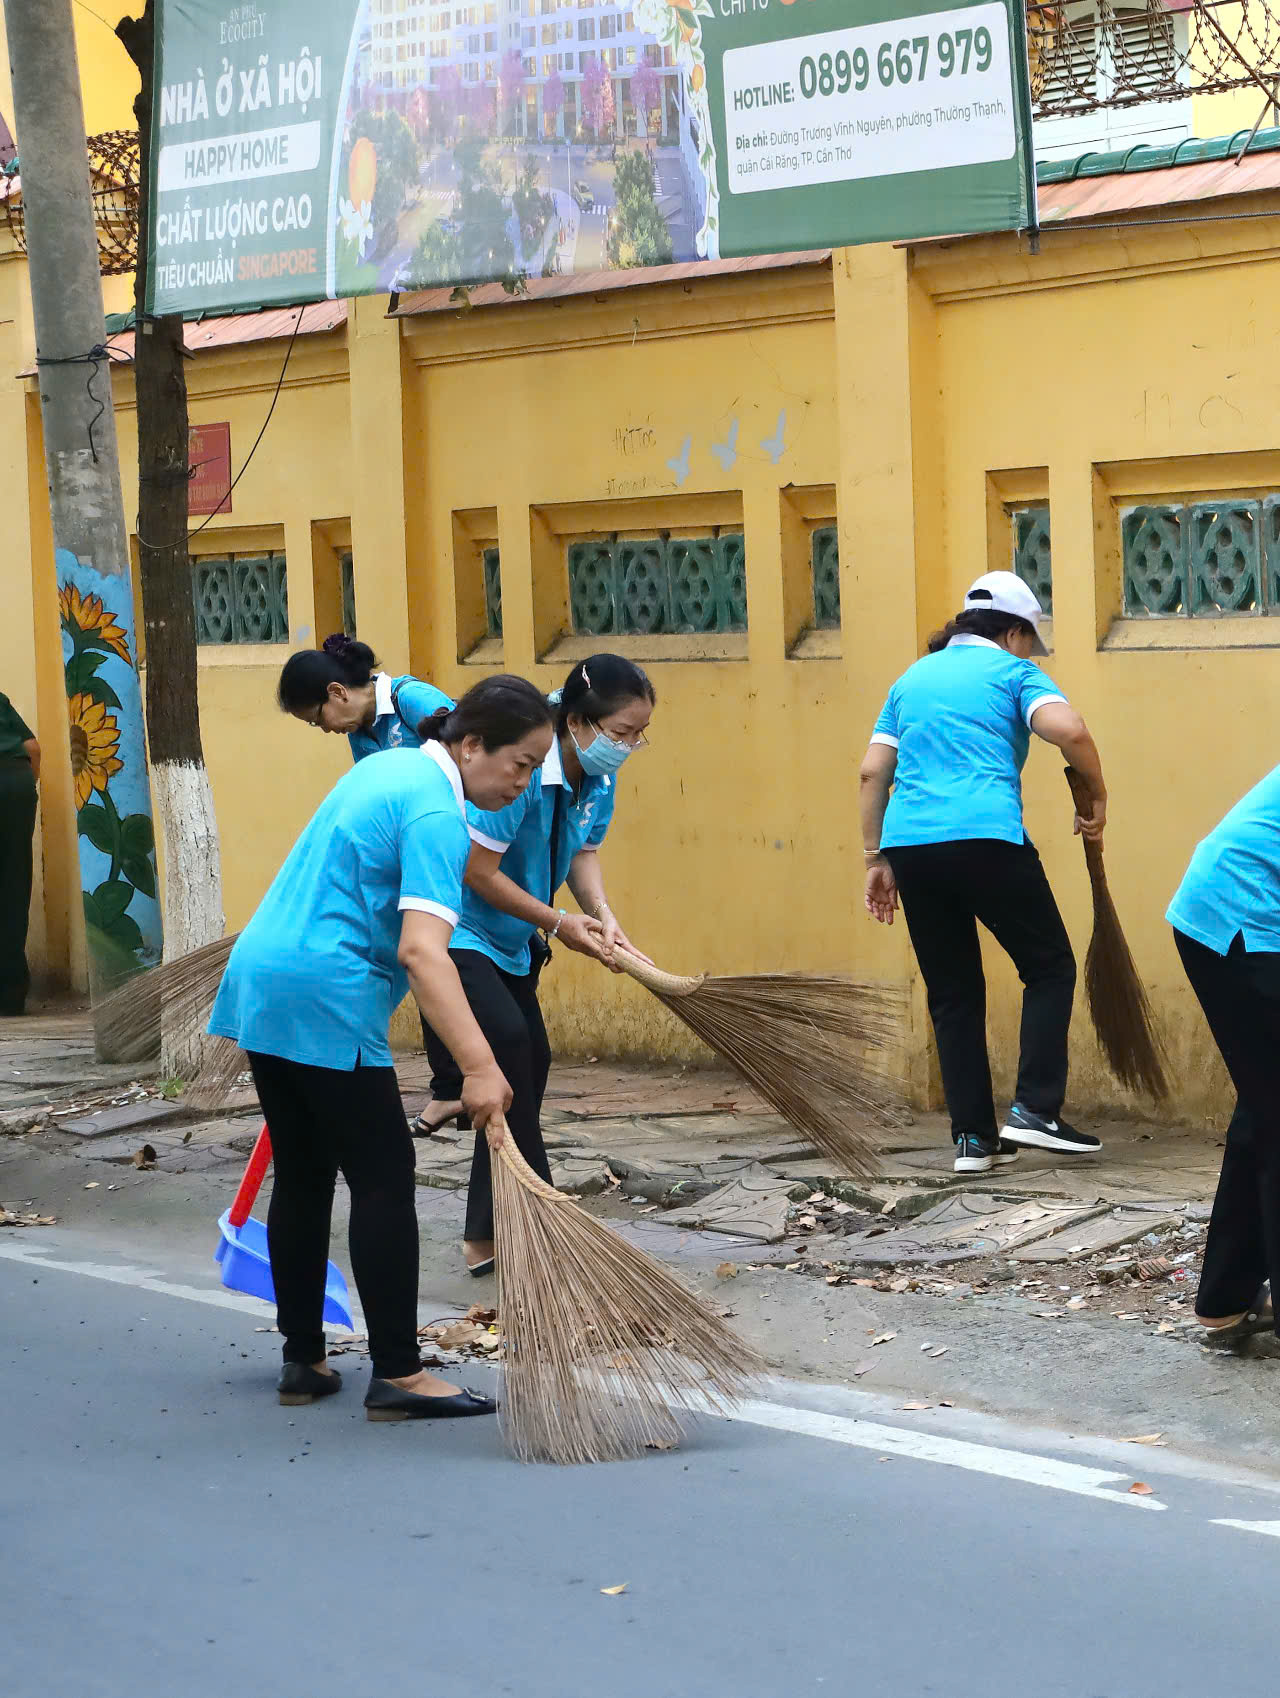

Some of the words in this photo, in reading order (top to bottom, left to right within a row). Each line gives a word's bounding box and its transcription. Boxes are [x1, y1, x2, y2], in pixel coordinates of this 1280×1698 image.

[160, 67, 209, 127] NHÀ
[215, 56, 234, 117] Ở
[238, 53, 272, 113] XÃ
[278, 45, 322, 115] HỘI
[733, 81, 796, 111] HOTLINE:
[799, 47, 870, 99] 0899
[877, 35, 930, 87] 667
[937, 26, 993, 78] 979
[735, 134, 751, 153] Địa
[770, 129, 800, 146] Đường
[800, 126, 832, 142] Trương
[856, 115, 895, 136] Nguyên,
[896, 110, 932, 132] phường
[933, 105, 971, 122] Thường
[971, 97, 1006, 120] Thạnh,
[184, 143, 238, 180] HAPPY
[240, 134, 289, 171] HOME
[736, 159, 759, 177] quận
[760, 155, 774, 172] Cái
[775, 153, 801, 171] Răng,
[800, 151, 815, 167] TP.
[834, 145, 853, 161] Thơ
[156, 195, 203, 246] CHẤT
[205, 197, 269, 248] LƯỢNG
[271, 193, 313, 232] CAO
[157, 258, 186, 290] TIÊU
[187, 247, 235, 287] CHUẨN
[237, 248, 318, 281] SINGAPORE
